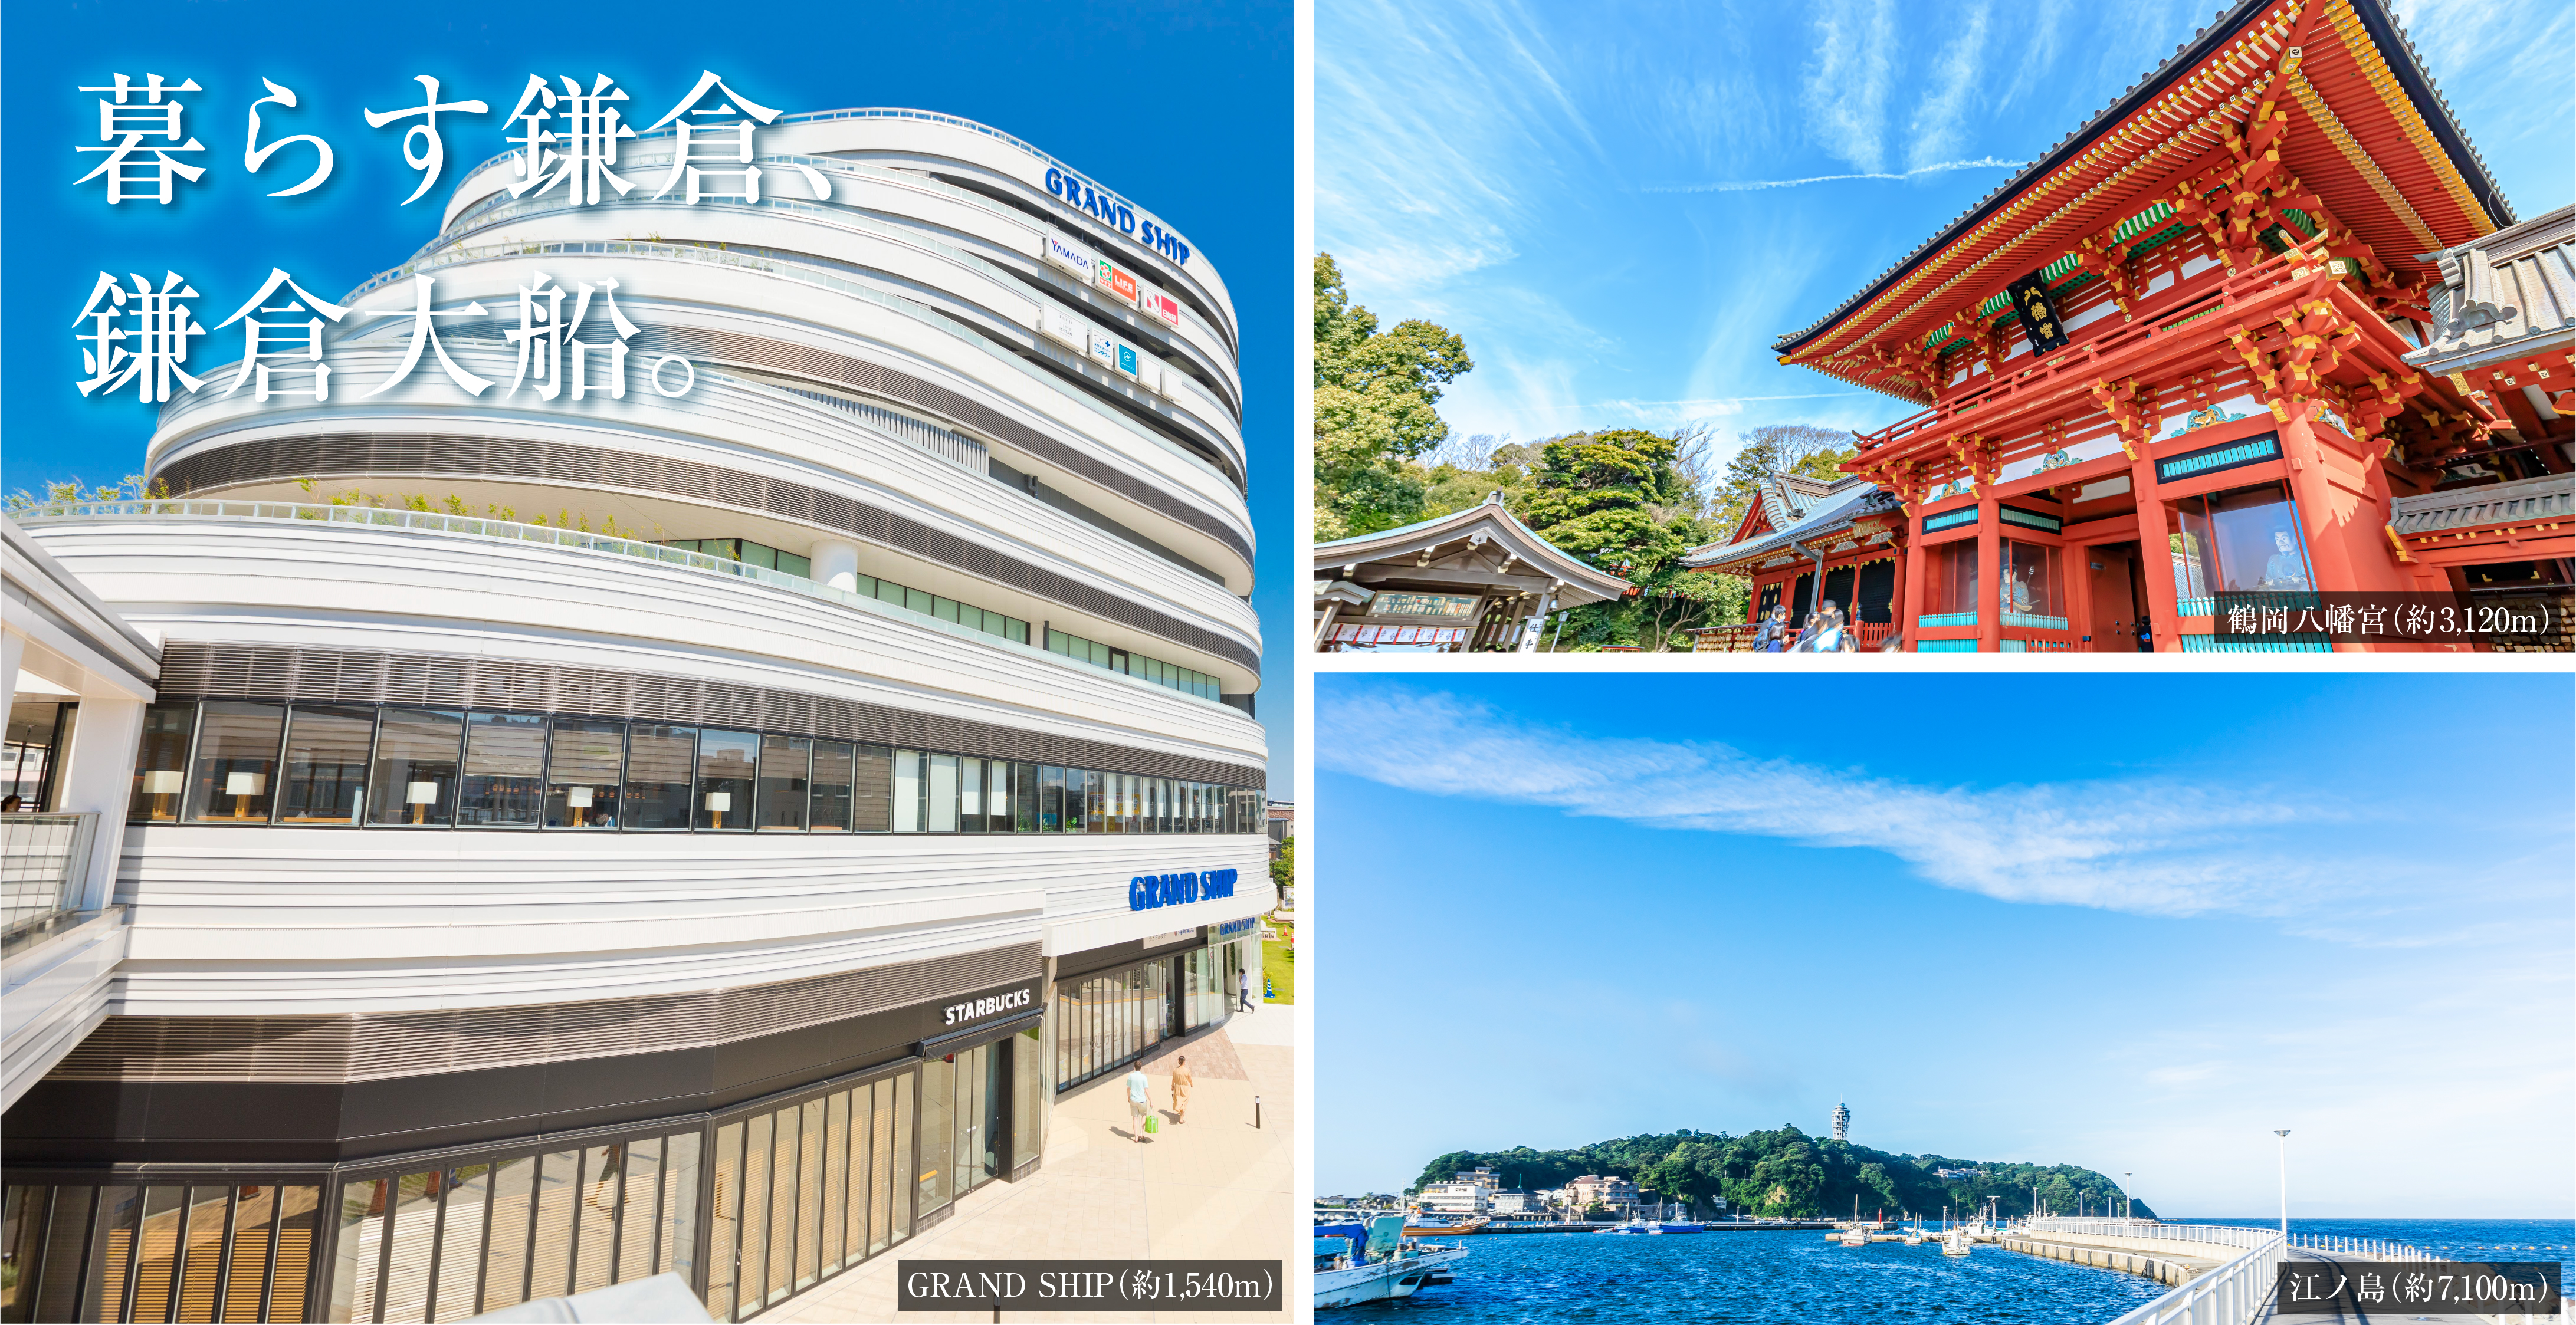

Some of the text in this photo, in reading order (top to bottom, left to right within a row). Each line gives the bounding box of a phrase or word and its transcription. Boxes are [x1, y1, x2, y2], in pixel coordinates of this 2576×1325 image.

[1045, 167, 1190, 265] GRAND SHIP
[1051, 238, 1088, 270] YAMADA
[1100, 278, 1111, 287] ライフ
[1115, 275, 1133, 290] LIFE
[1094, 347, 1111, 359] コンタクト
[1129, 868, 1238, 912] GRAND SHIP
[1220, 917, 1255, 936] GRAND SHIP
[945, 989, 1030, 1025] STARBUCKS
